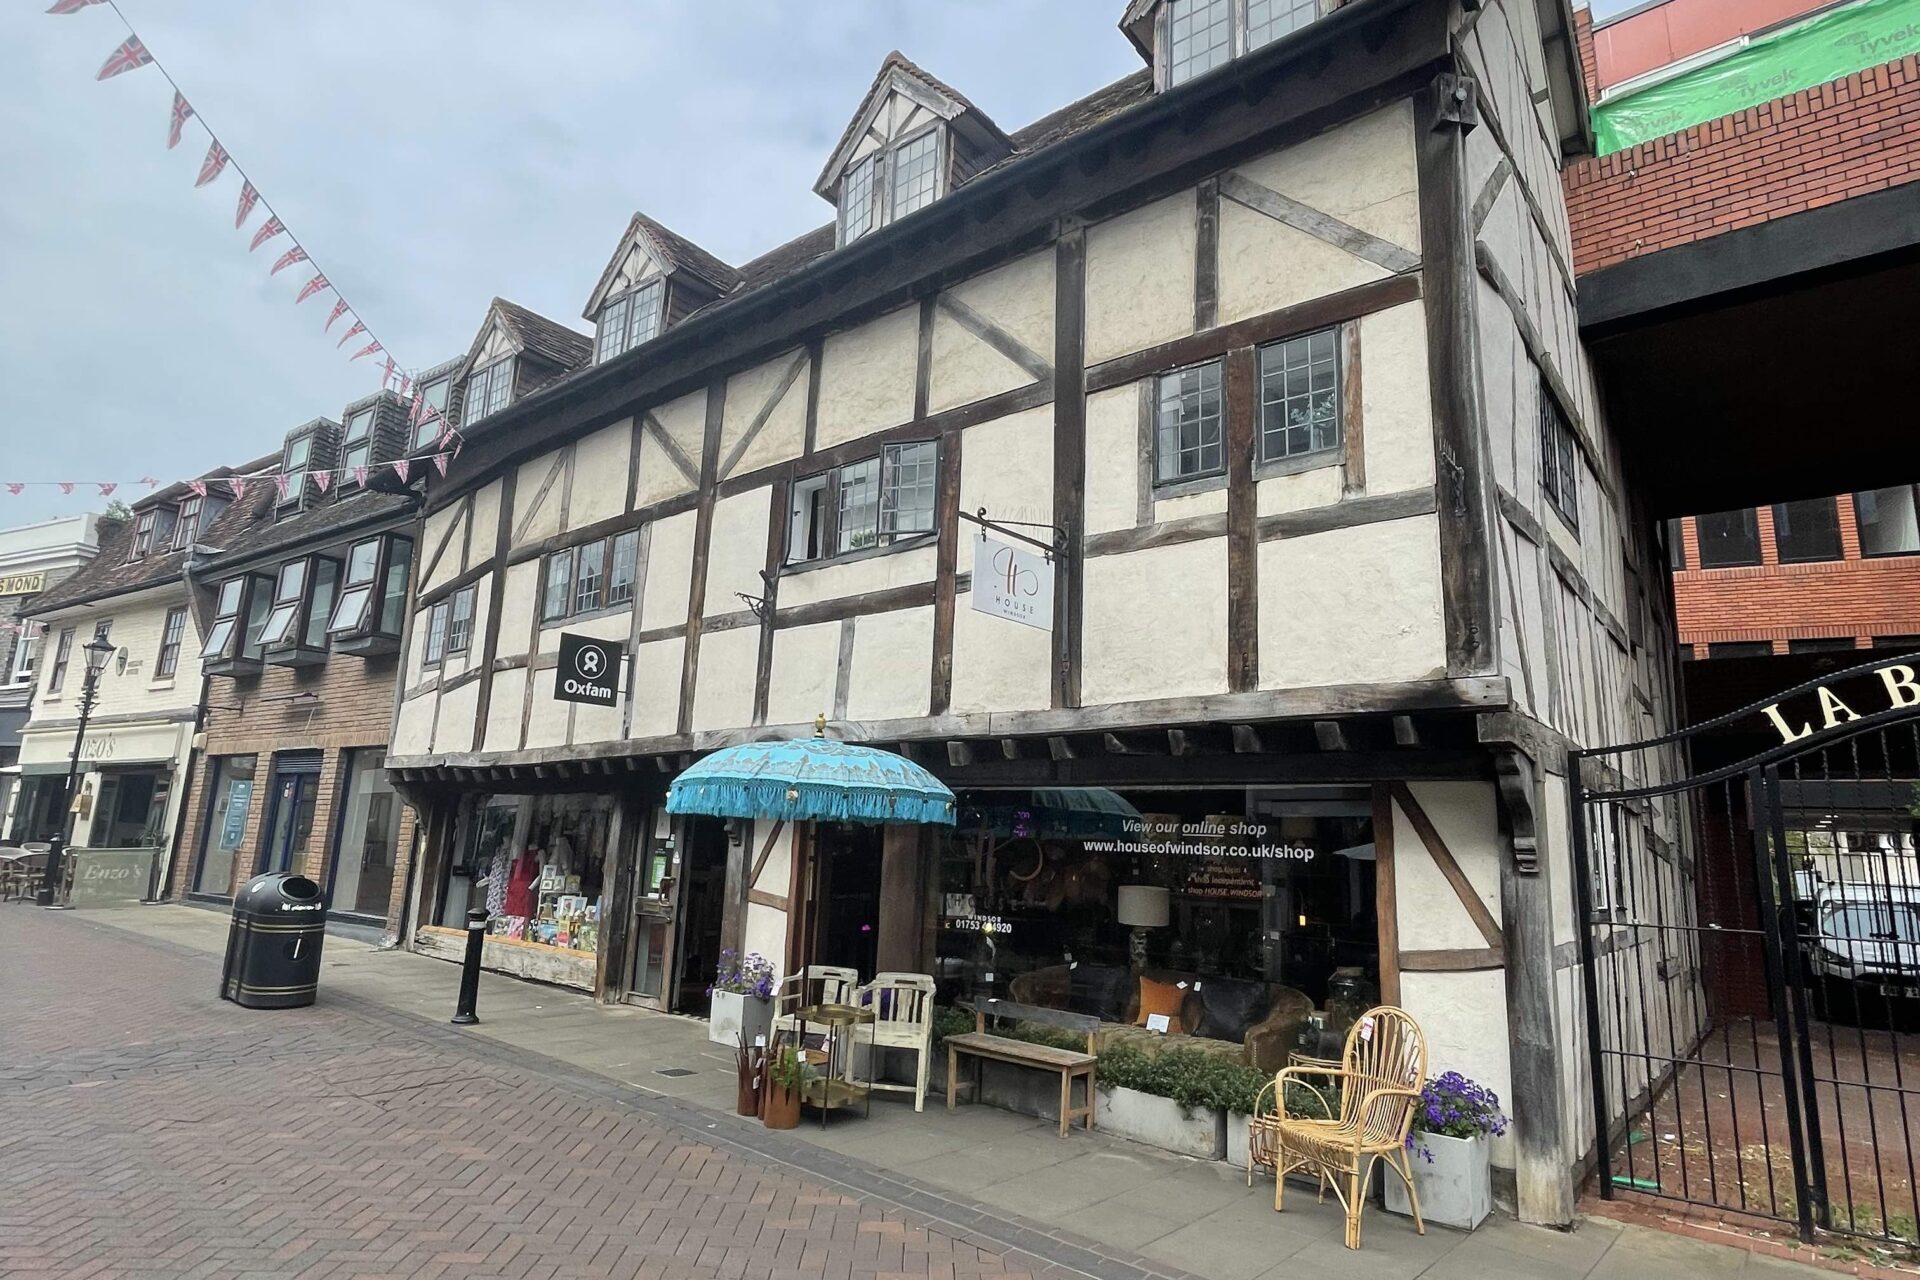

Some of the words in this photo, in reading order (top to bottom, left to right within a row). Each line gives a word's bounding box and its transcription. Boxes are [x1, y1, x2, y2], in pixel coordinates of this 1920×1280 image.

[995, 595, 1034, 614] HOUSE
[564, 679, 612, 699] Oxfam
[69, 732, 117, 759] nzo's
[1122, 819, 1153, 833] View
[1155, 823, 1179, 833] our
[1182, 821, 1225, 835] online
[1229, 821, 1267, 838] shop
[1083, 839, 1315, 863] www.houseofwindsor.co.uk/shop
[83, 864, 144, 879] Enzo's
[955, 918, 980, 930] 01753
[967, 914, 1002, 923] WINDSOR
